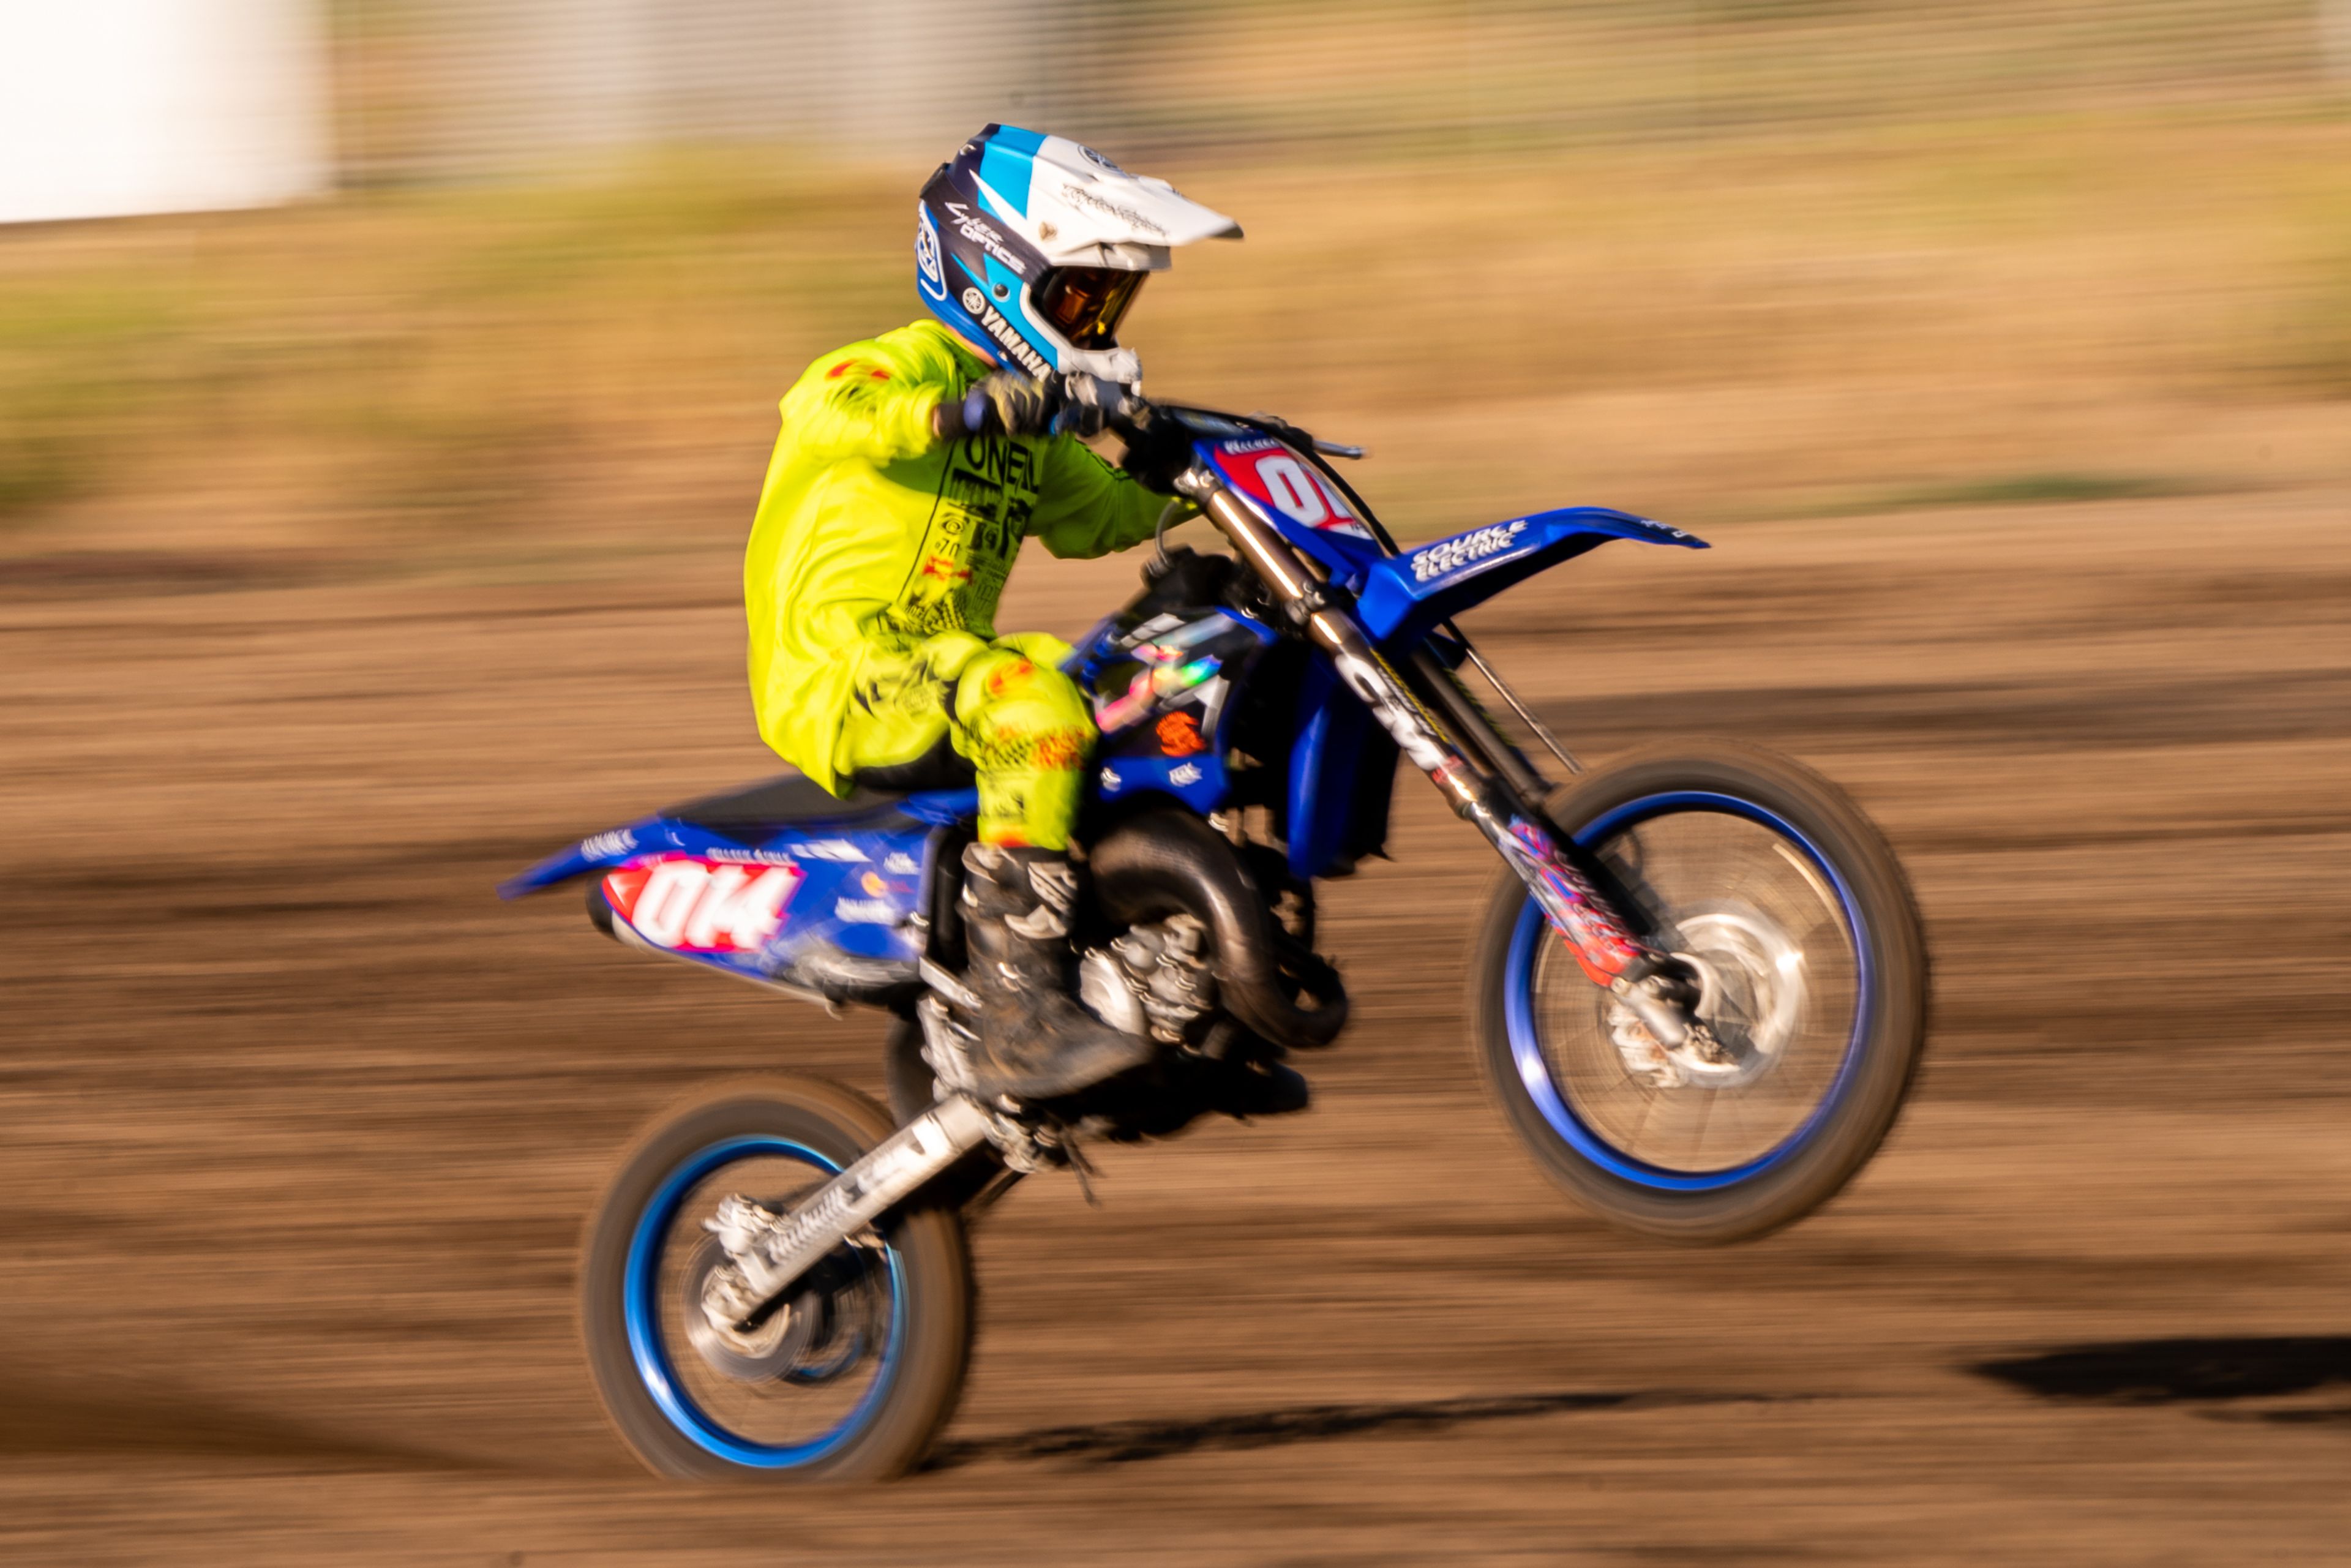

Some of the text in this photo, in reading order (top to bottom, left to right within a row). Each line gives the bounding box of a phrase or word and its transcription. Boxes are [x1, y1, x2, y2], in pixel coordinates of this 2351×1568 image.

[960, 223, 1027, 275] OPTICS
[981, 305, 1052, 383] YAMAHA
[1411, 520, 1528, 571] SOURCE
[1415, 531, 1517, 582] ELECTRIC
[631, 859, 800, 950] 014
